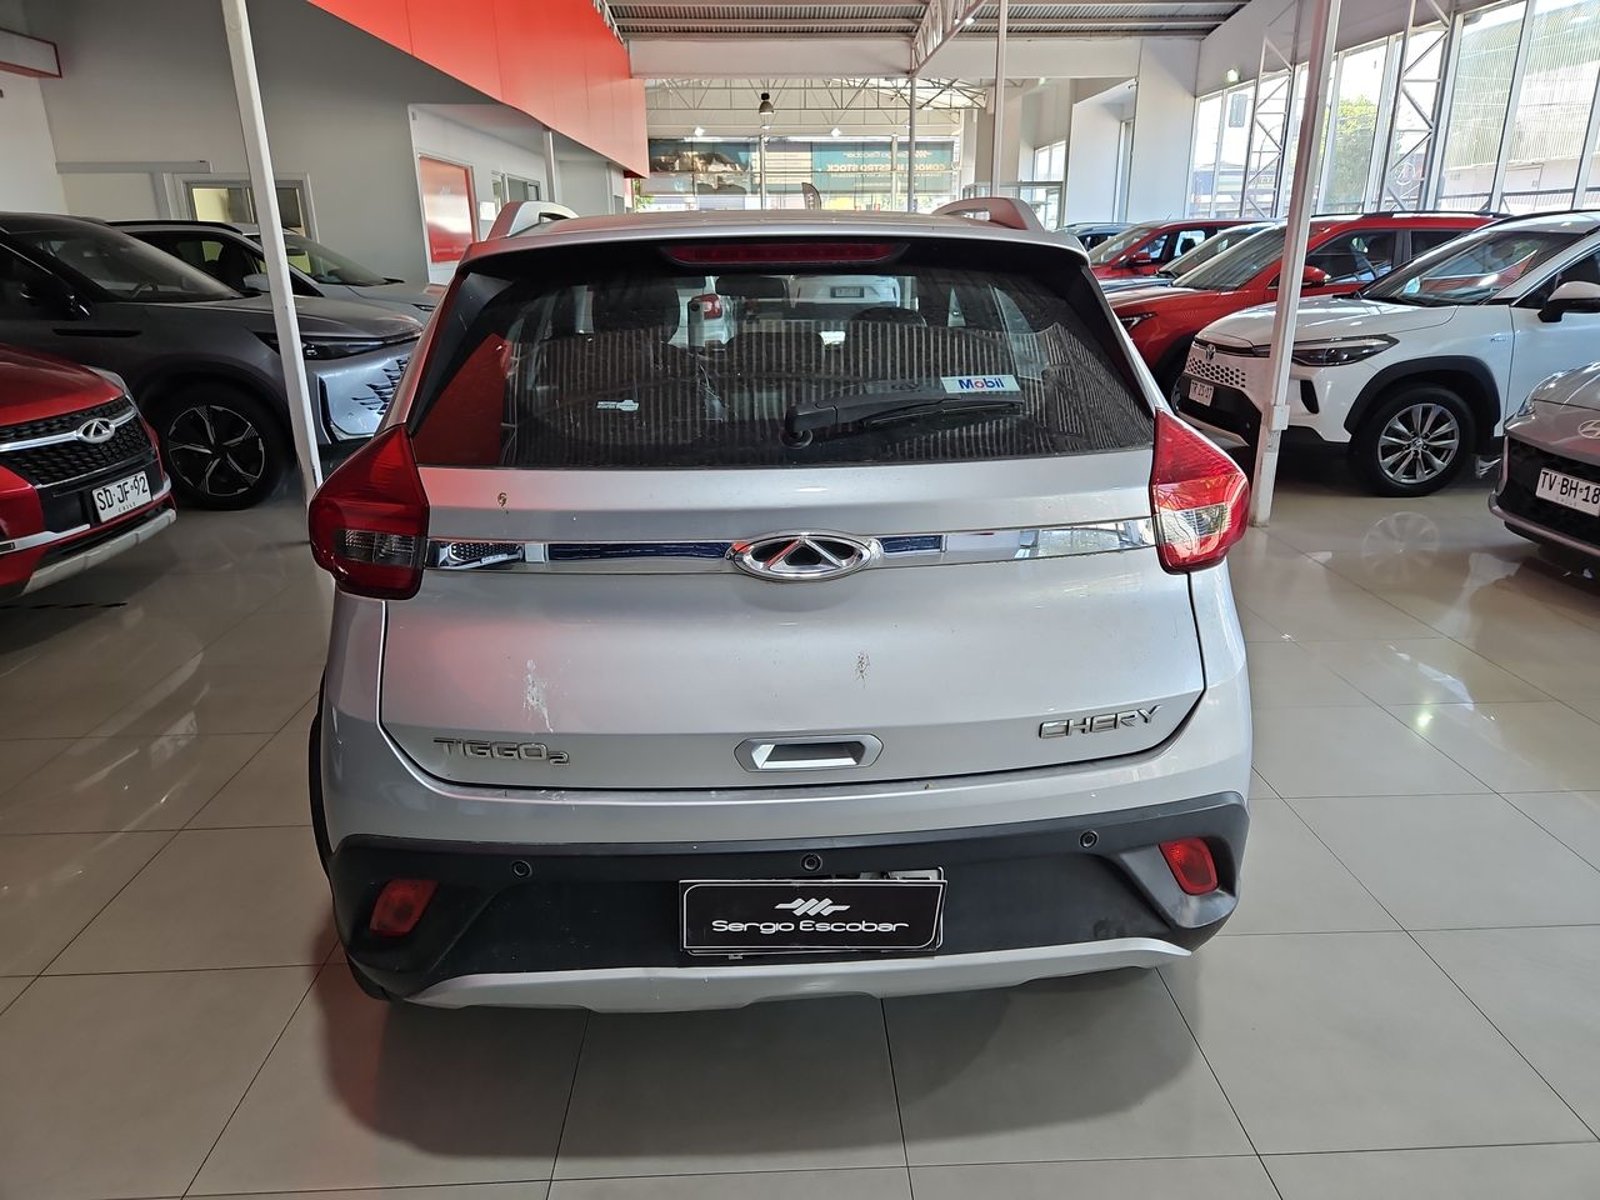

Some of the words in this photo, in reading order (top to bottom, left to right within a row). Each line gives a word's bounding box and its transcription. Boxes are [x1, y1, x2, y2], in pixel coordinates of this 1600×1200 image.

[958, 378, 1004, 389] Mobil
[1039, 704, 1162, 739] CHERY
[712, 920, 795, 934] Sergio
[799, 920, 909, 932] Escobar
